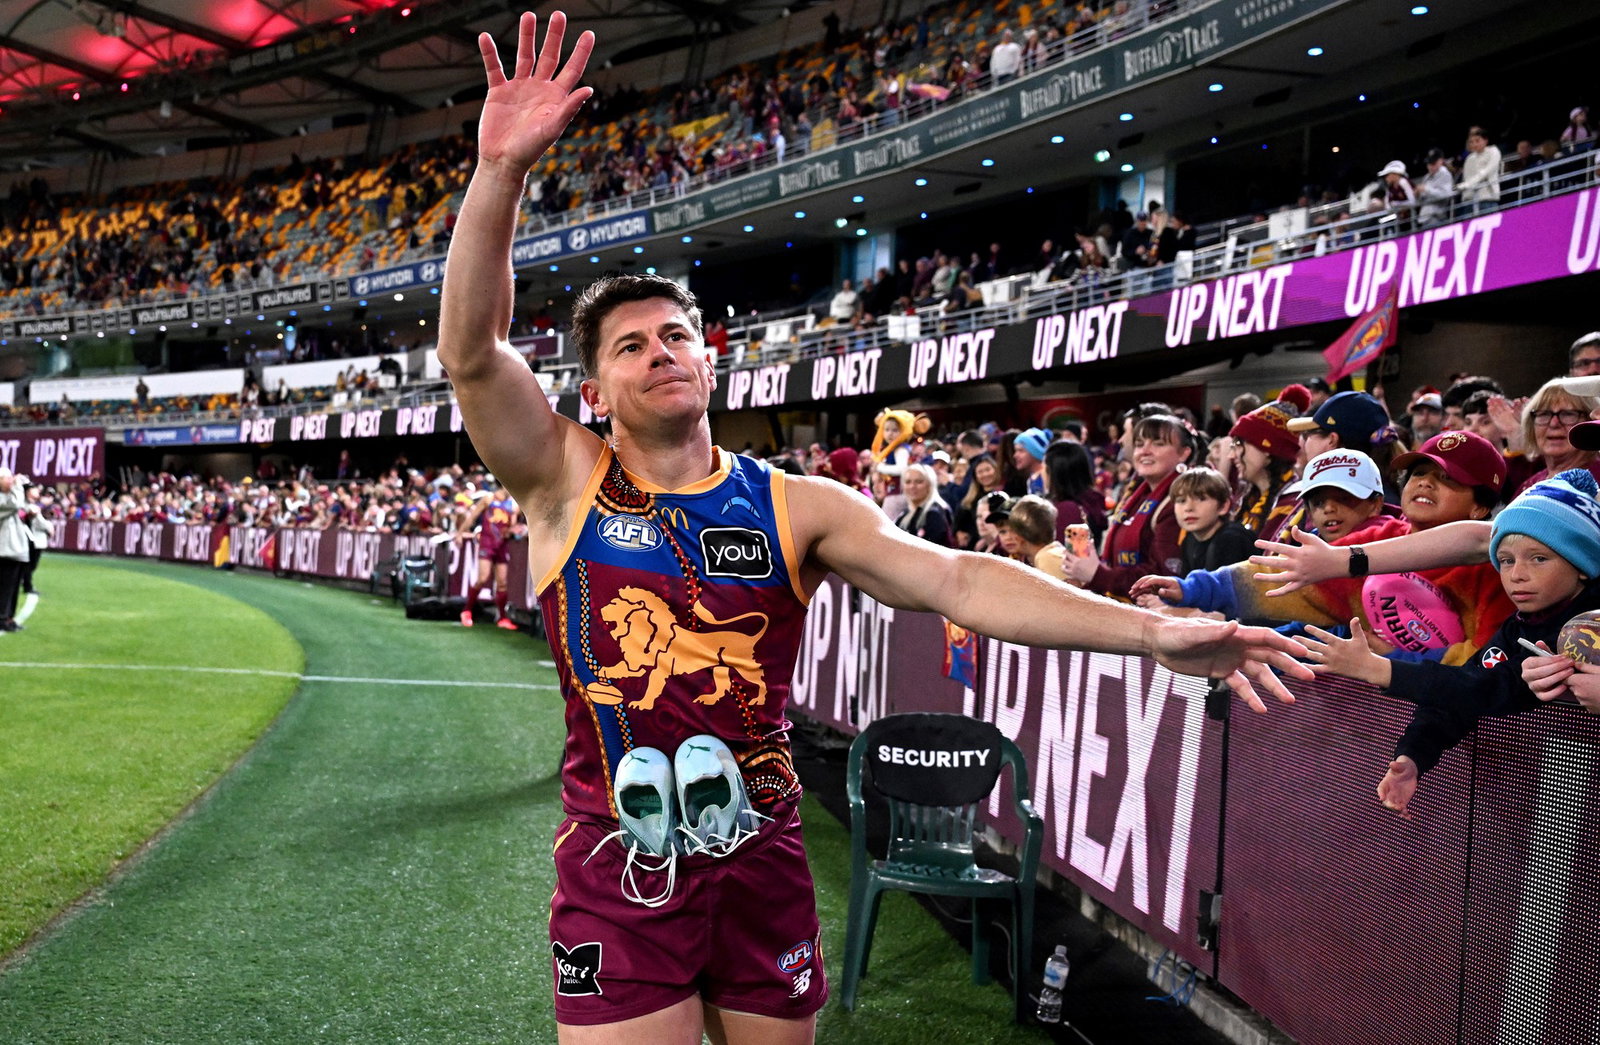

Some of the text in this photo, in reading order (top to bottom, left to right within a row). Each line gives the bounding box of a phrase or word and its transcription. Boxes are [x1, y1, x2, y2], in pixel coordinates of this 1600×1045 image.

[1123, 19, 1222, 82] BUFFALO TRACE
[1020, 65, 1104, 120] BUFFALO TRACE
[590, 215, 647, 246] HYUNDAI
[1567, 187, 1600, 274] U
[371, 268, 415, 291] HYUNDAI
[1344, 213, 1503, 317] UP NEXT
[1165, 263, 1293, 348] UP NEXT
[1031, 301, 1129, 370] UP NEXT
[811, 349, 882, 400] UP NEXT
[907, 328, 995, 389] UP NEXT
[726, 364, 790, 410] UP NEXT
[250, 417, 276, 443] NEXT
[289, 414, 329, 441] UP NEXT
[340, 409, 382, 438] UP NEXT
[395, 405, 438, 436] UP NEXT
[32, 436, 97, 477] UP NEXT
[1348, 468, 1357, 478] 3
[77, 520, 91, 551] UP
[124, 521, 141, 555] UP
[174, 524, 212, 561] UP NEXT
[229, 527, 244, 564] UP
[280, 529, 322, 573] UP NEXT
[602, 519, 656, 547] AFL
[710, 537, 763, 566] youi
[335, 531, 381, 580] UP NEXT
[1379, 595, 1431, 655] ERRIN
[1423, 618, 1440, 634] SOFT
[792, 580, 894, 732] UP NEXT
[878, 744, 991, 768] SECURITY
[1033, 649, 1213, 934] NEXT
[556, 957, 590, 979] Keri
[782, 945, 812, 969] AFL
